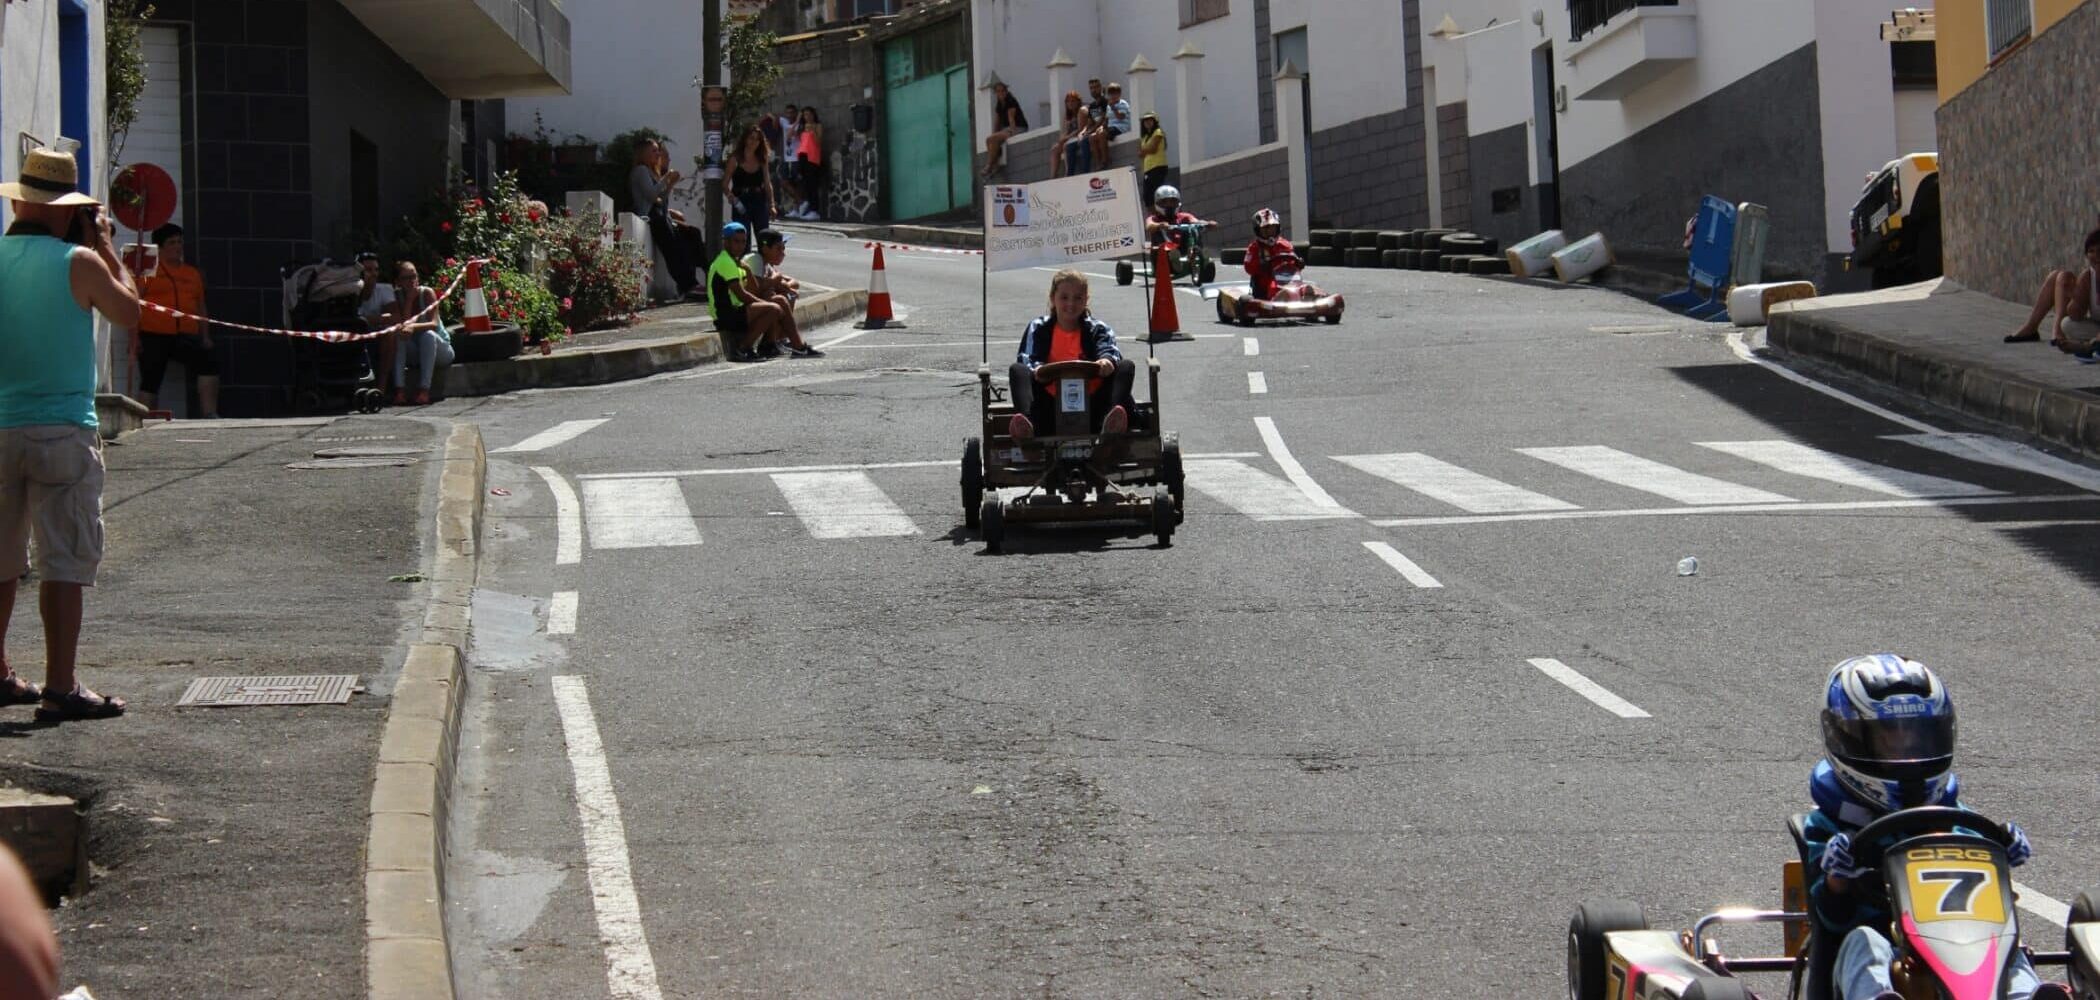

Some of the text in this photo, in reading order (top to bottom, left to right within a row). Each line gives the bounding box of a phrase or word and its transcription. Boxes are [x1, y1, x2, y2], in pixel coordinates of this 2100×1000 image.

[1020, 208, 1109, 231] sociación
[991, 222, 1132, 252] Carros de Madera
[1064, 239, 1120, 256] TENERIFE
[1883, 703, 1926, 714] SHIRO
[1907, 848, 1992, 860] CRG
[1918, 868, 1992, 915] 7
